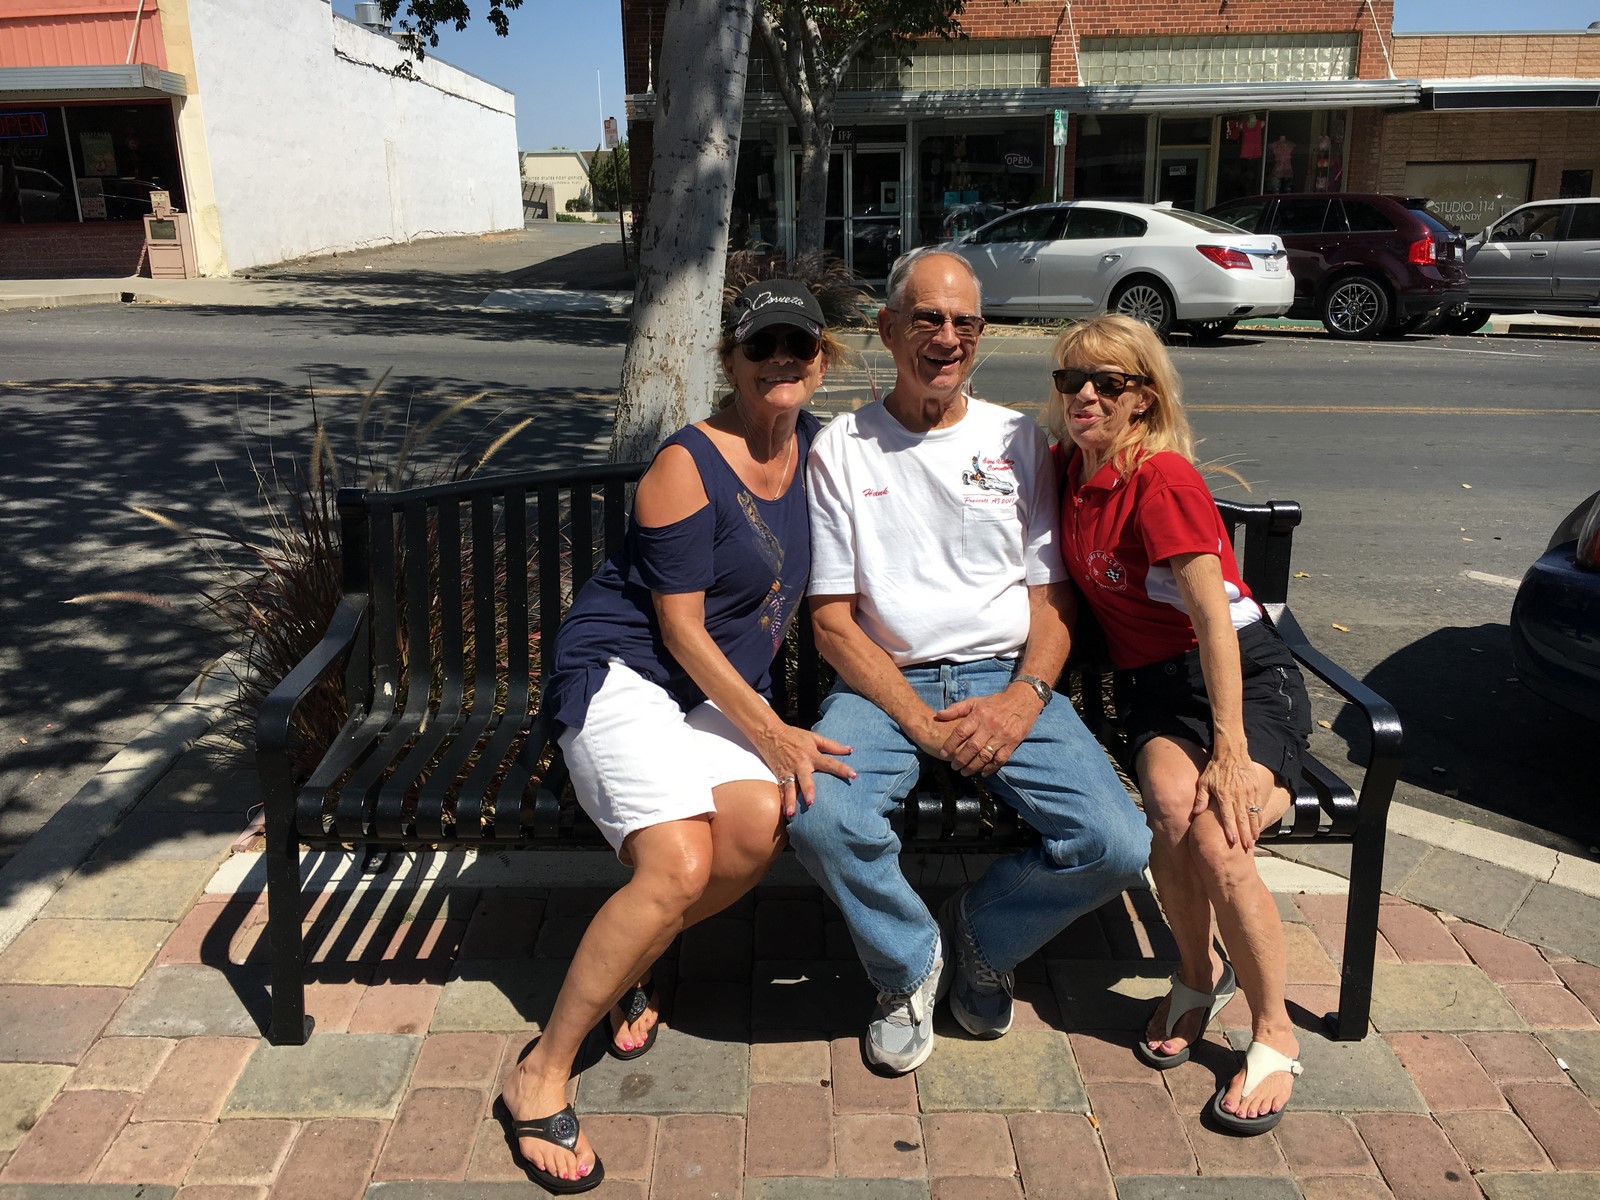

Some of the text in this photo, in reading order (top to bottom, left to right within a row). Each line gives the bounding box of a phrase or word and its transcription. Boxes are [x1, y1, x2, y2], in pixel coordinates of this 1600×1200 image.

[1006, 155, 1030, 165] OPEN
[1433, 201, 1495, 214] STUDIO 114
[1444, 213, 1482, 222] BY SANDY
[752, 291, 806, 310] Corvette
[862, 486, 890, 498] Hank
